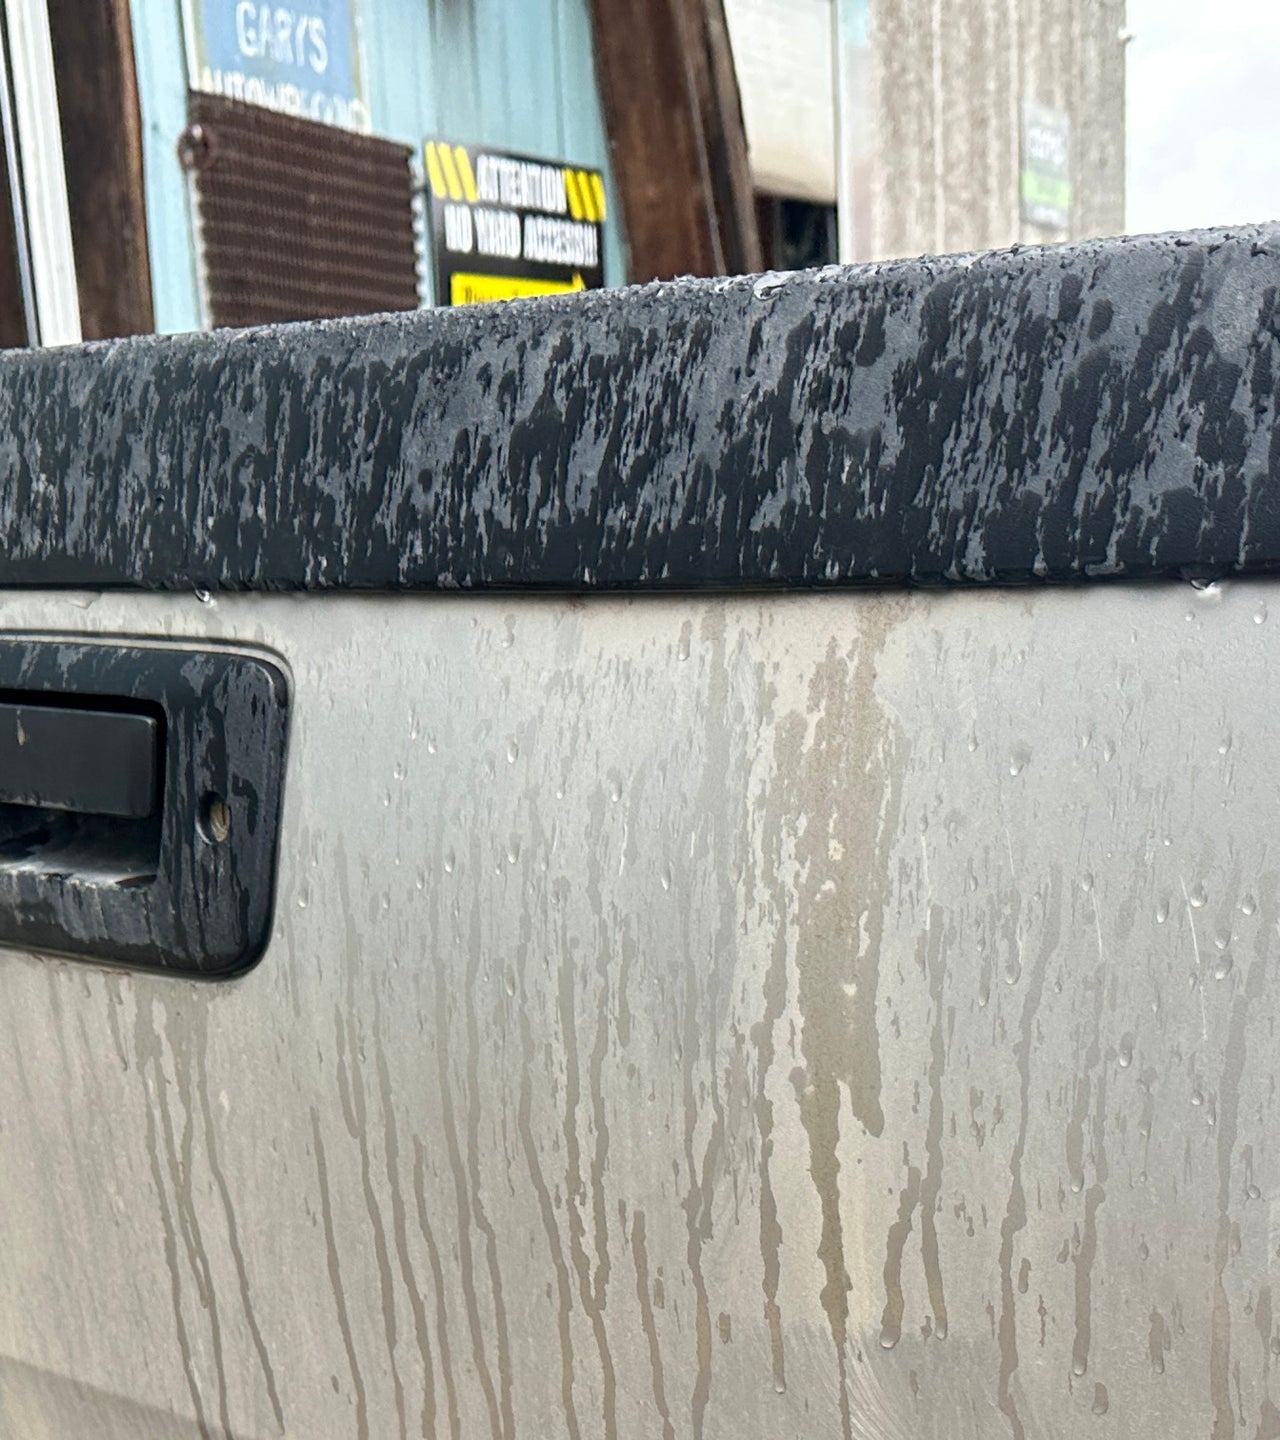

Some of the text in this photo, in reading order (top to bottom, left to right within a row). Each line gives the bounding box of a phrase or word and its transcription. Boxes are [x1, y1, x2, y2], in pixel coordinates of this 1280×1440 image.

[477, 154, 566, 213] ATTENTION
[444, 203, 473, 254] NO
[474, 207, 521, 259] YARD
